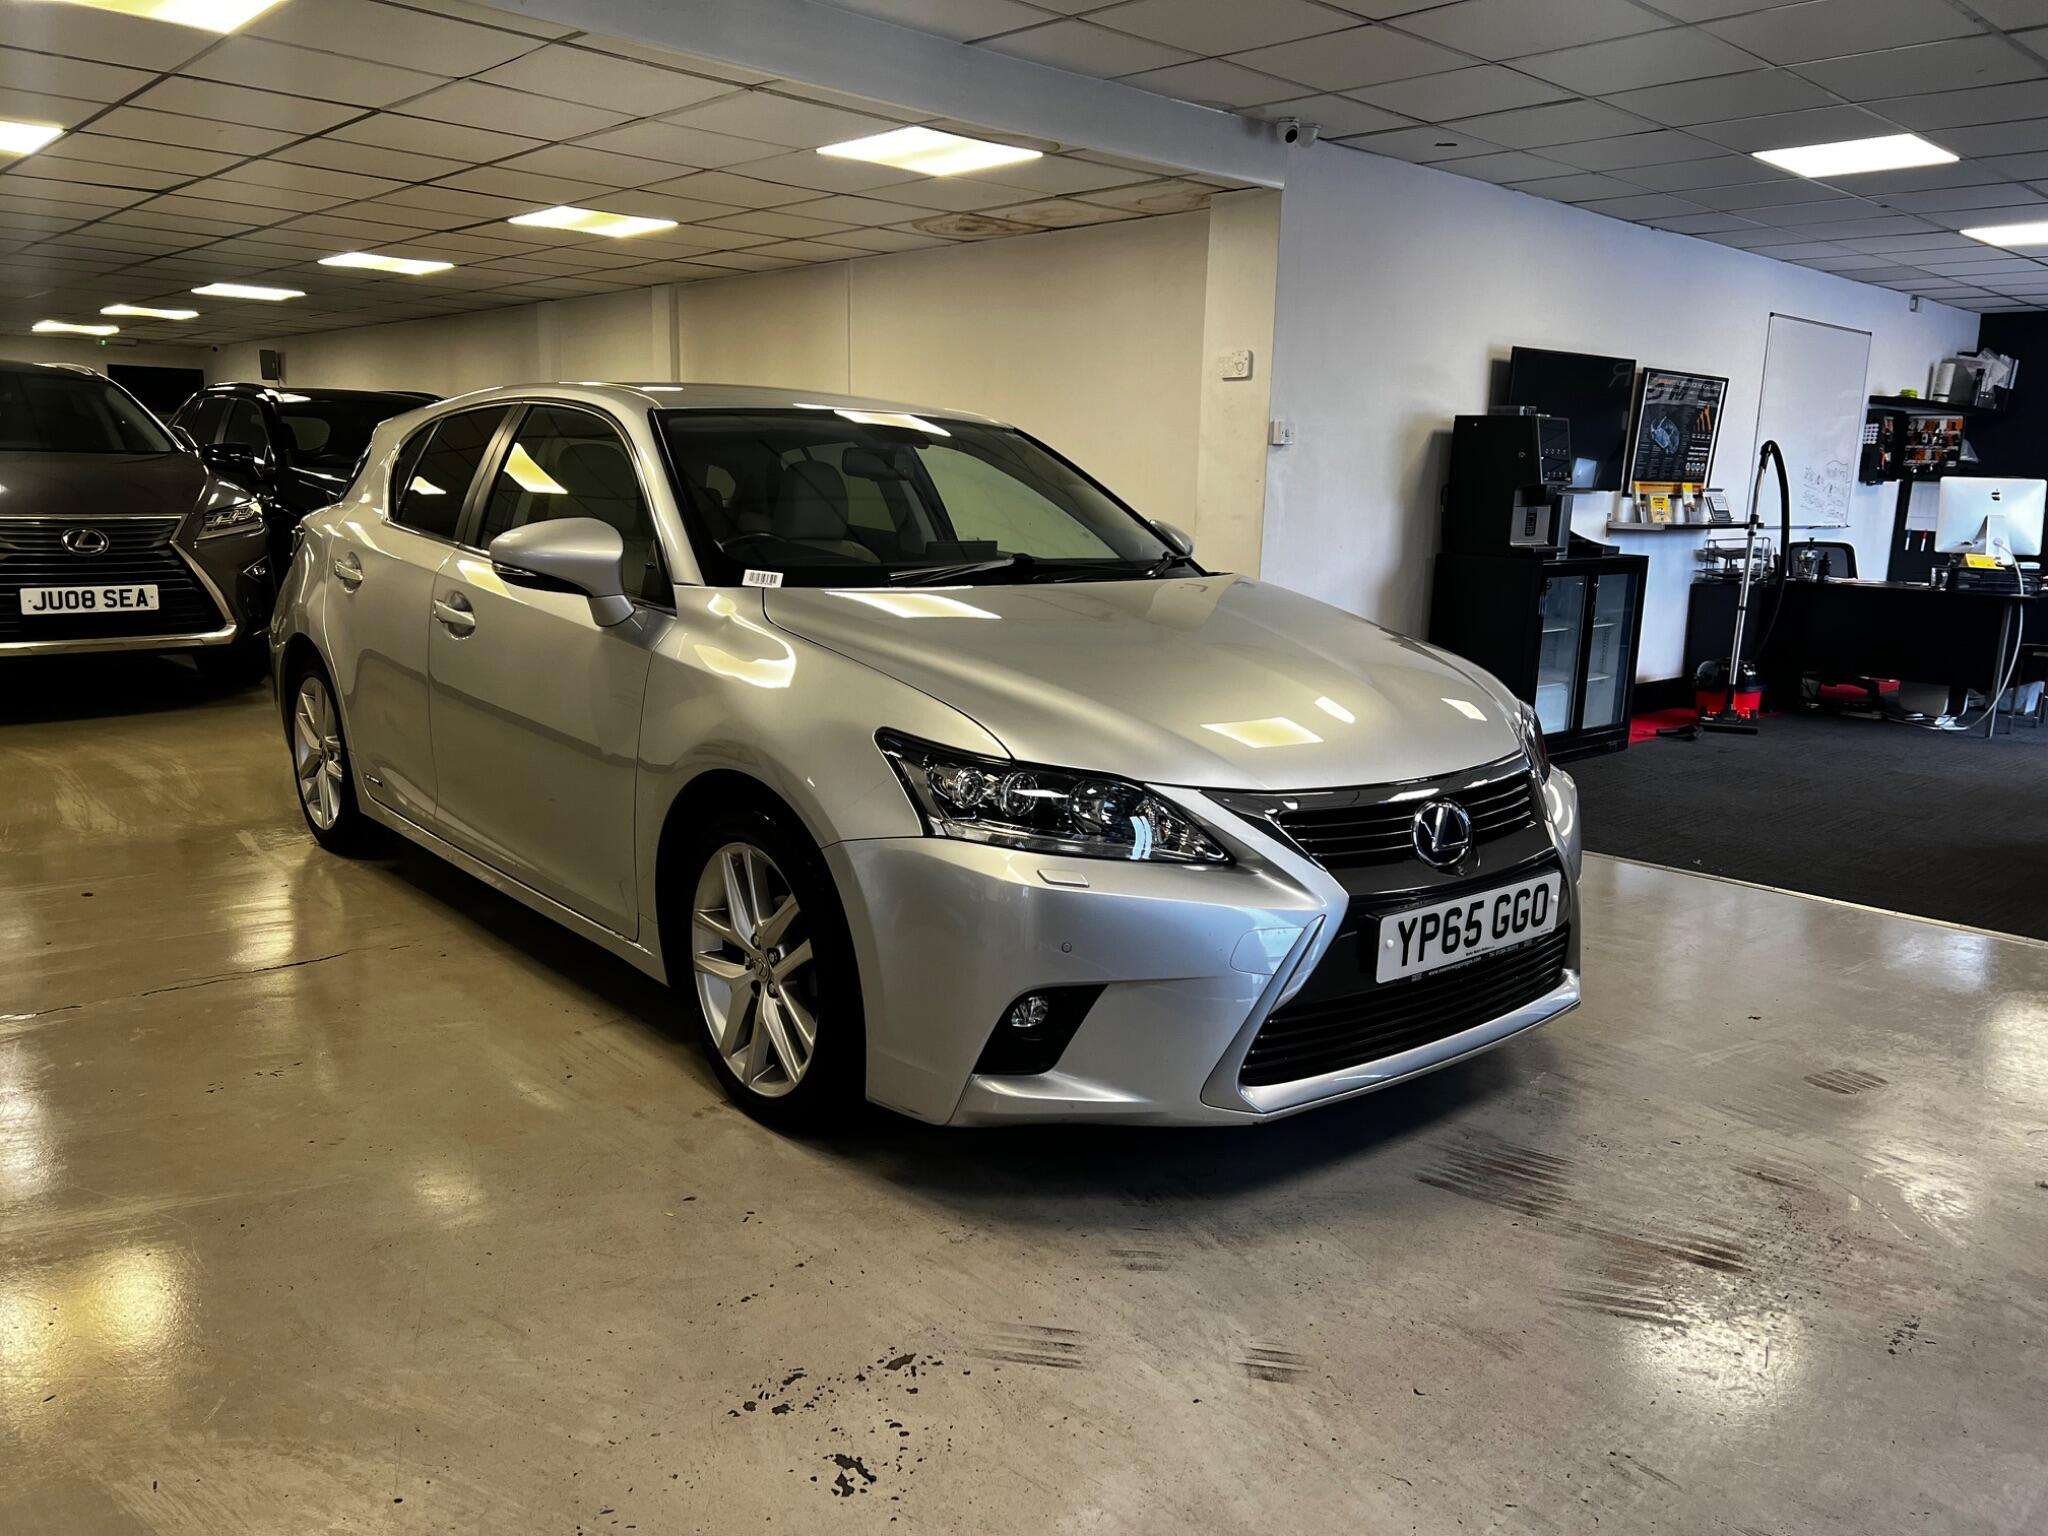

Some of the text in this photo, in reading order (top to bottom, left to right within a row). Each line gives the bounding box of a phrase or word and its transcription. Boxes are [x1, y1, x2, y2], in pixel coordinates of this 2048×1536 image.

[32, 588, 149, 611] JU08 SEA
[1398, 883, 1549, 967] YP65 GGO
